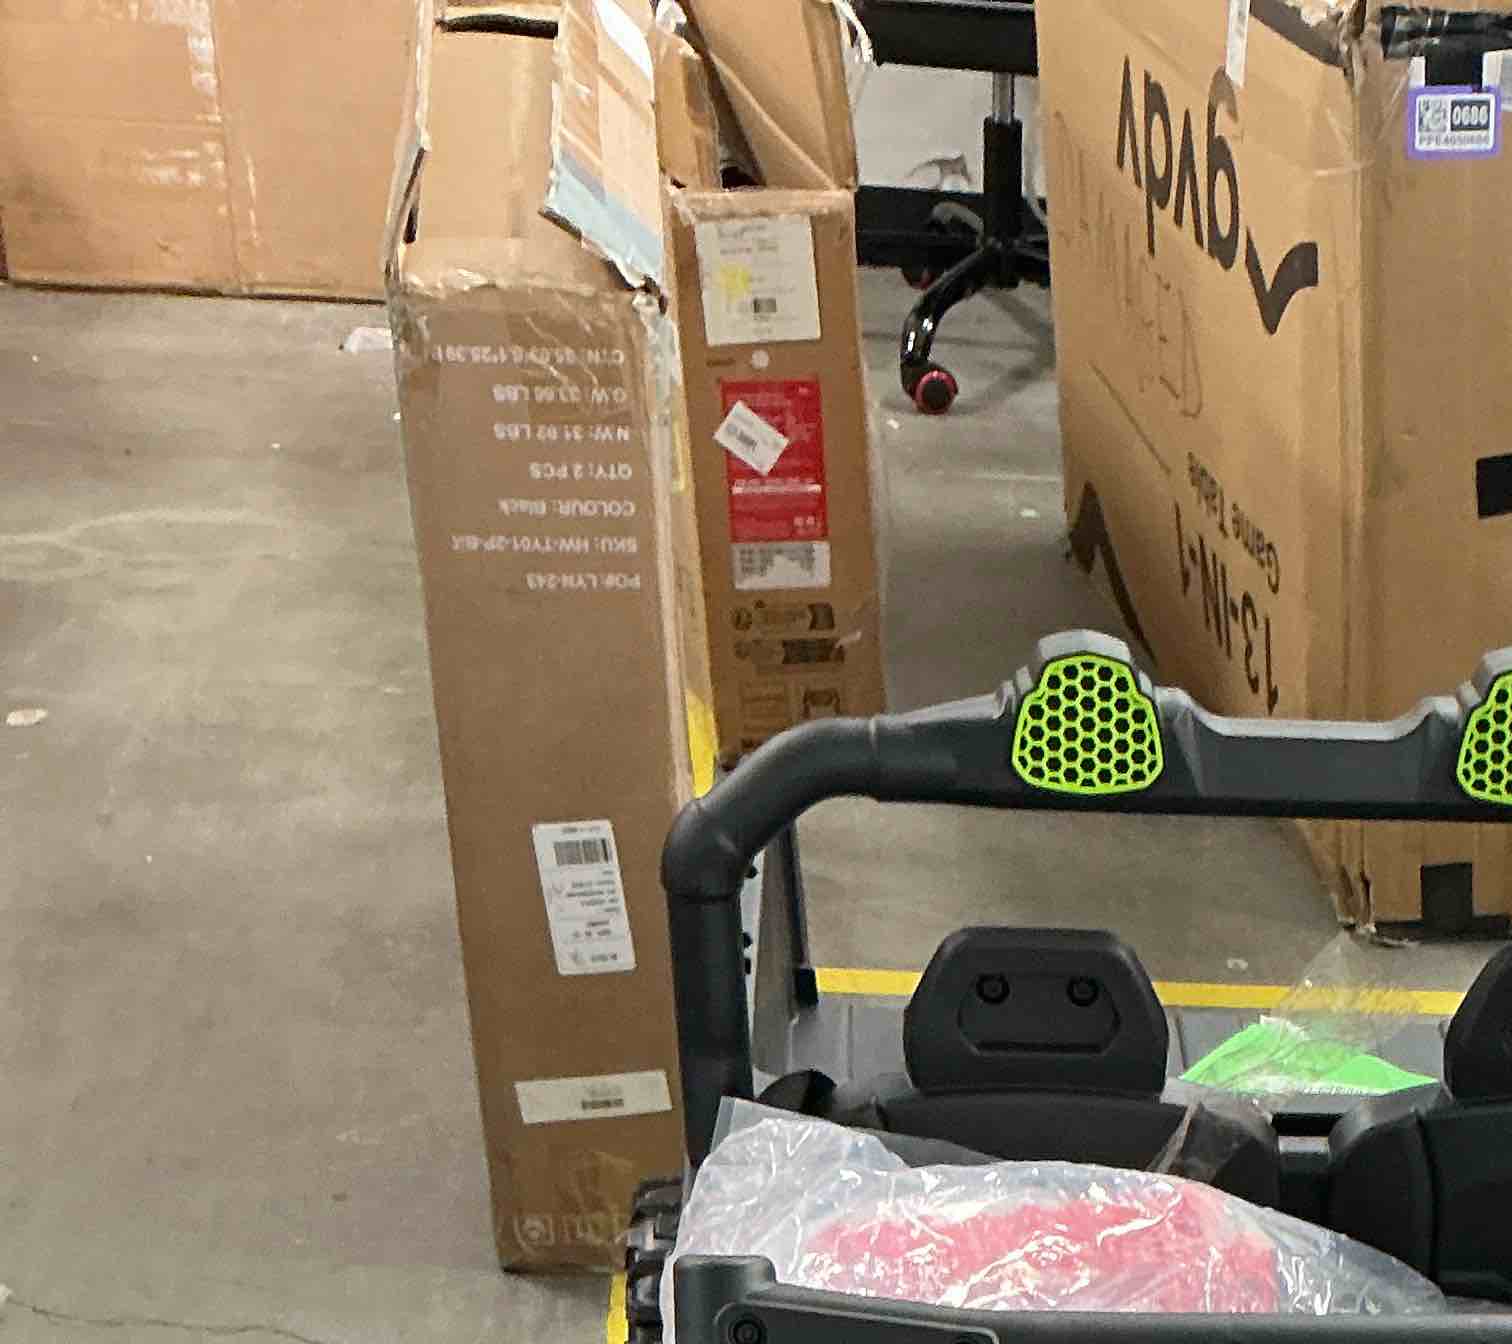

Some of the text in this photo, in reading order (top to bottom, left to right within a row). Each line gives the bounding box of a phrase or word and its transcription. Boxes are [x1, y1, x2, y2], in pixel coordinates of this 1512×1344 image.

[528, 462, 568, 480] PCS
[573, 464, 584, 479] 2
[498, 498, 546, 516] Black
